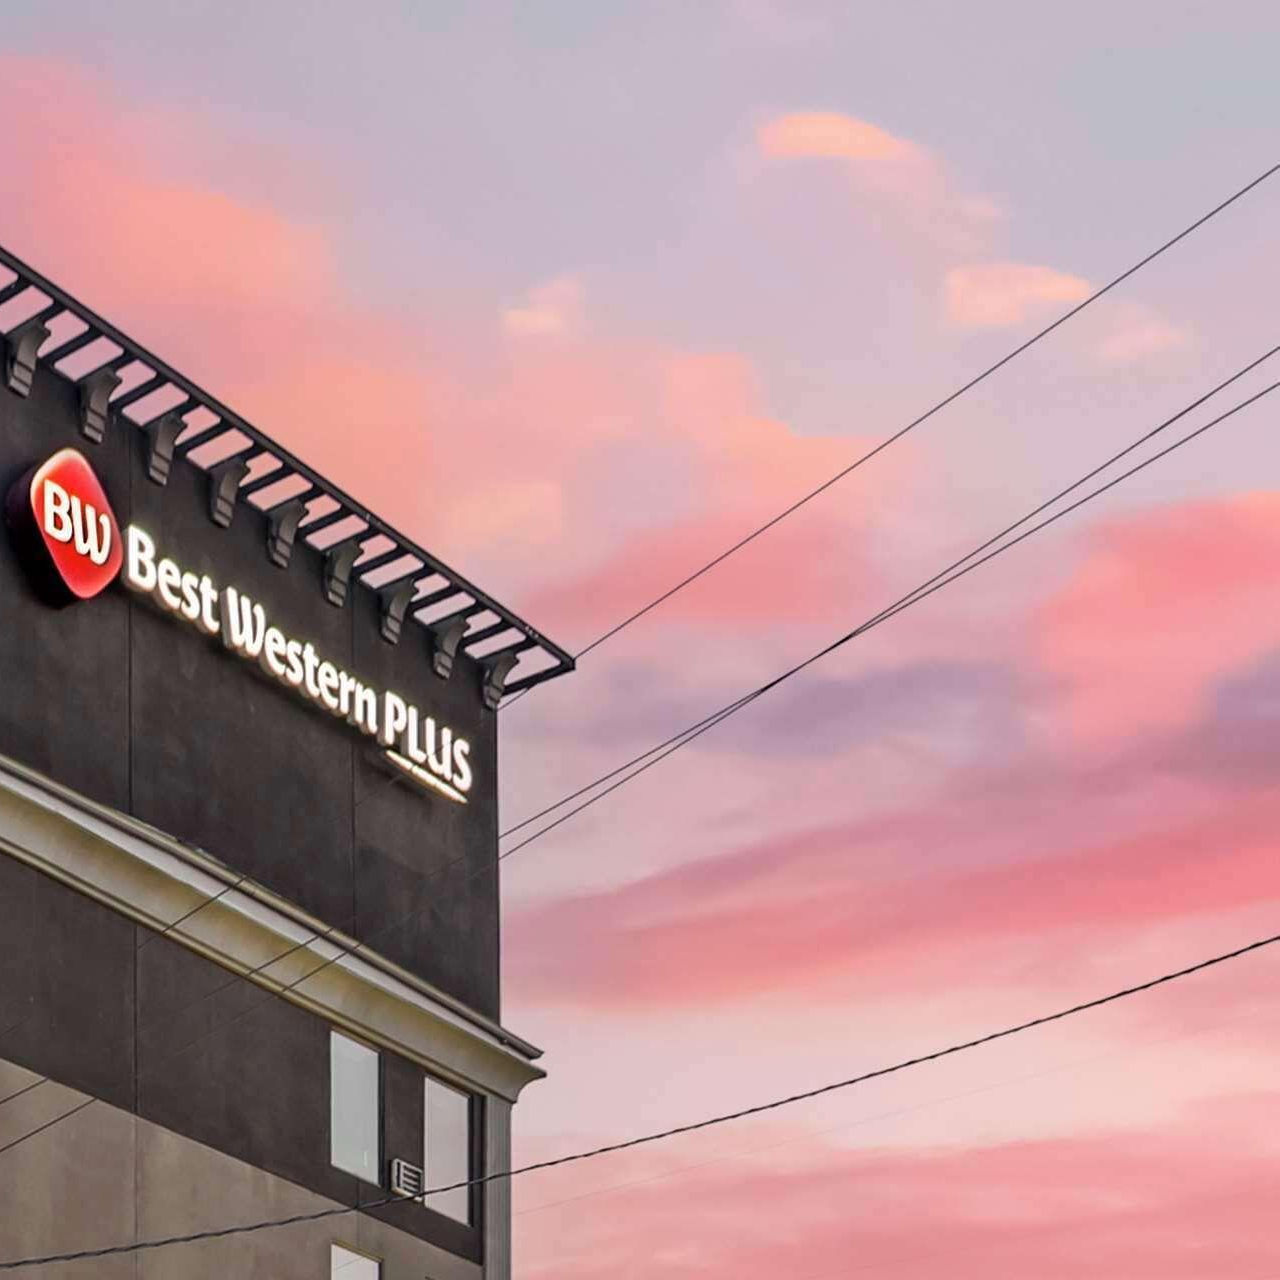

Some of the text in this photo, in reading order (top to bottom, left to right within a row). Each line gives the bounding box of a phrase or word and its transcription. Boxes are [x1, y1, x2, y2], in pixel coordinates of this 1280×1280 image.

[43, 478, 112, 566] BW
[125, 524, 473, 793] Best Western PLUS
